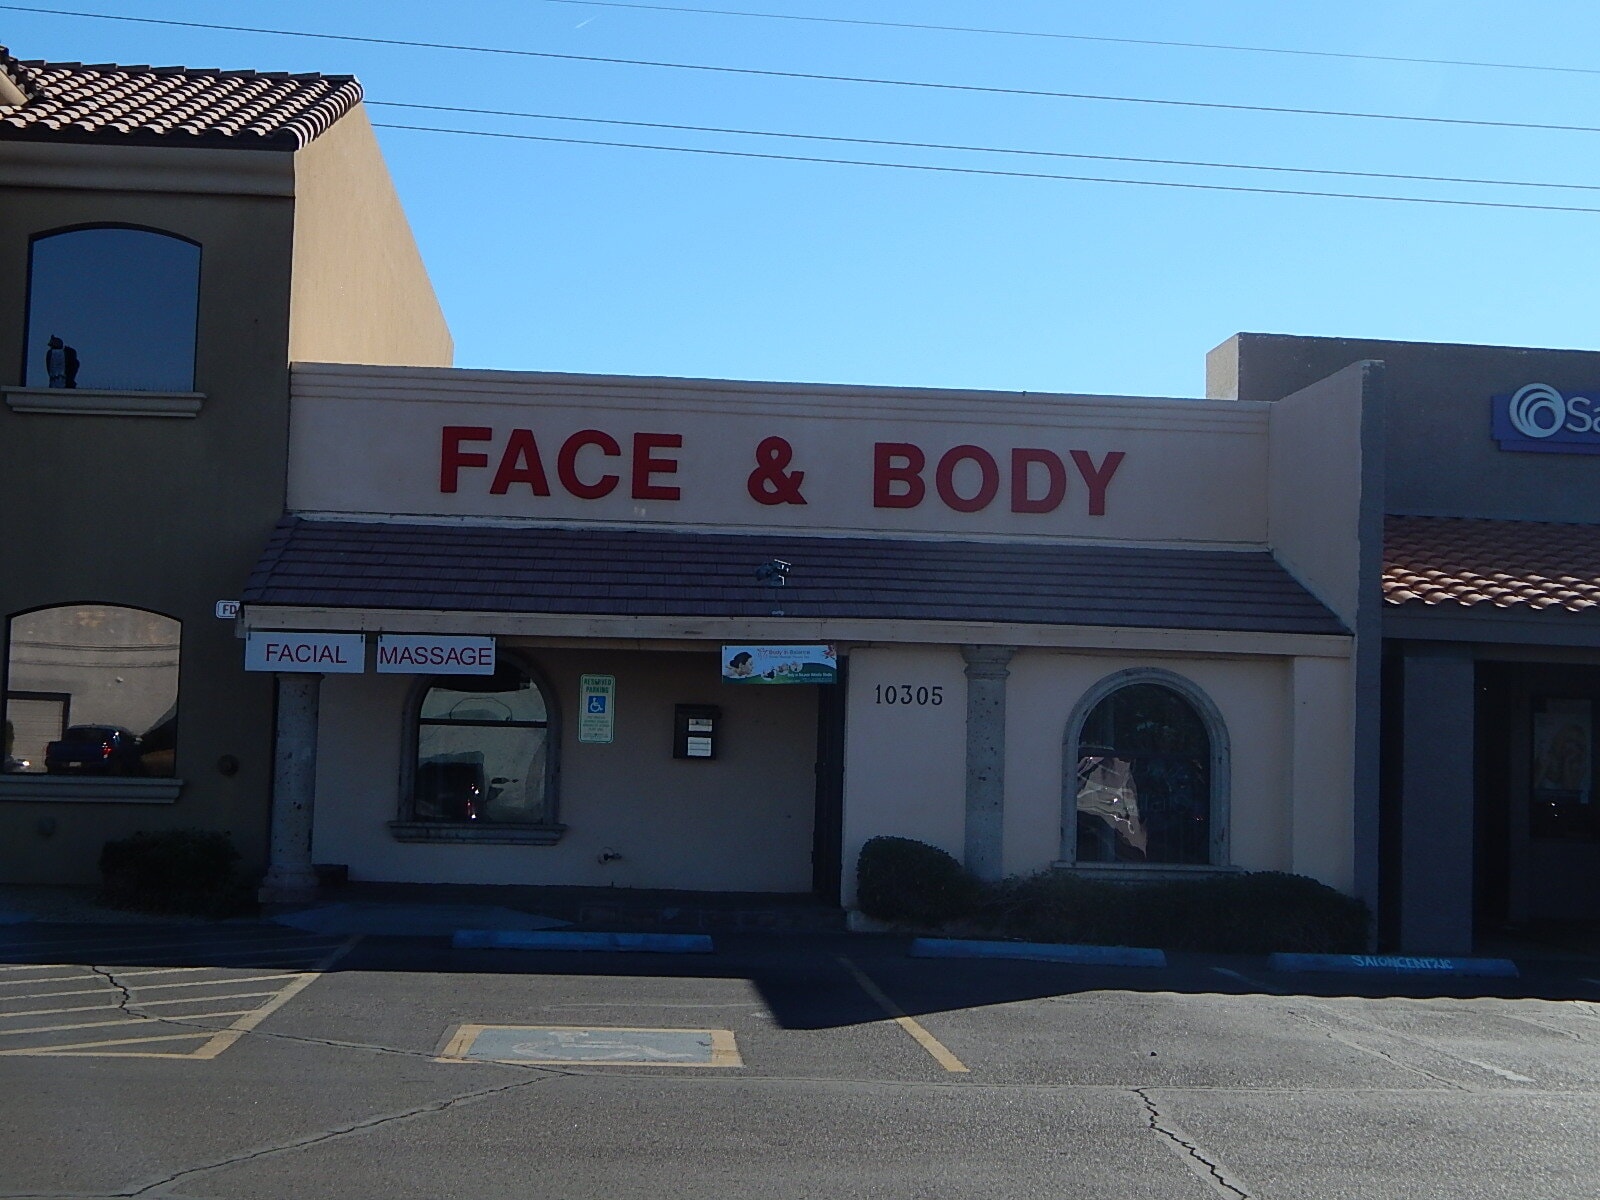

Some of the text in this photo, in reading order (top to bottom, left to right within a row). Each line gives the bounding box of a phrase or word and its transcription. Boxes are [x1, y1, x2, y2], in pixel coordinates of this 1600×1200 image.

[440, 426, 1126, 516] FACE & BODY
[265, 643, 347, 664] FACIAL
[379, 646, 492, 666] MASSAGE
[584, 678, 612, 686] RESERVED
[876, 684, 943, 705] 10305
